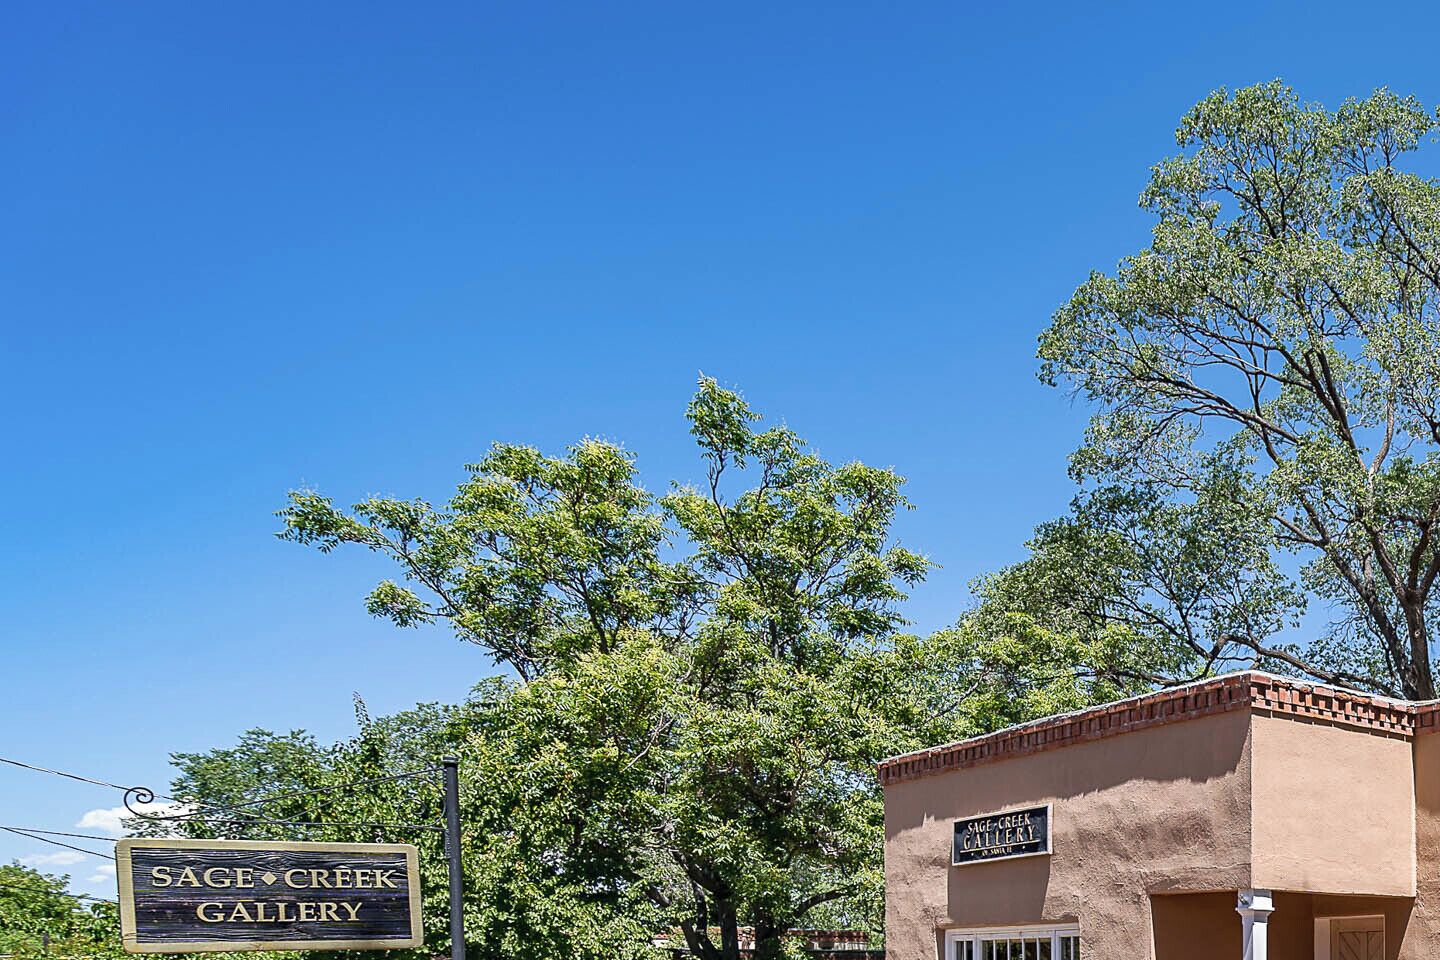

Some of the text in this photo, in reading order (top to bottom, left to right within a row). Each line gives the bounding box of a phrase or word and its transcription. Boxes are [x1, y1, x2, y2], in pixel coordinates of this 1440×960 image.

[967, 812, 1031, 835] SAGE CREEK
[963, 825, 1035, 850] GALLERY
[151, 866, 398, 889] SAGE CREEK
[196, 901, 363, 923] GALLERY
